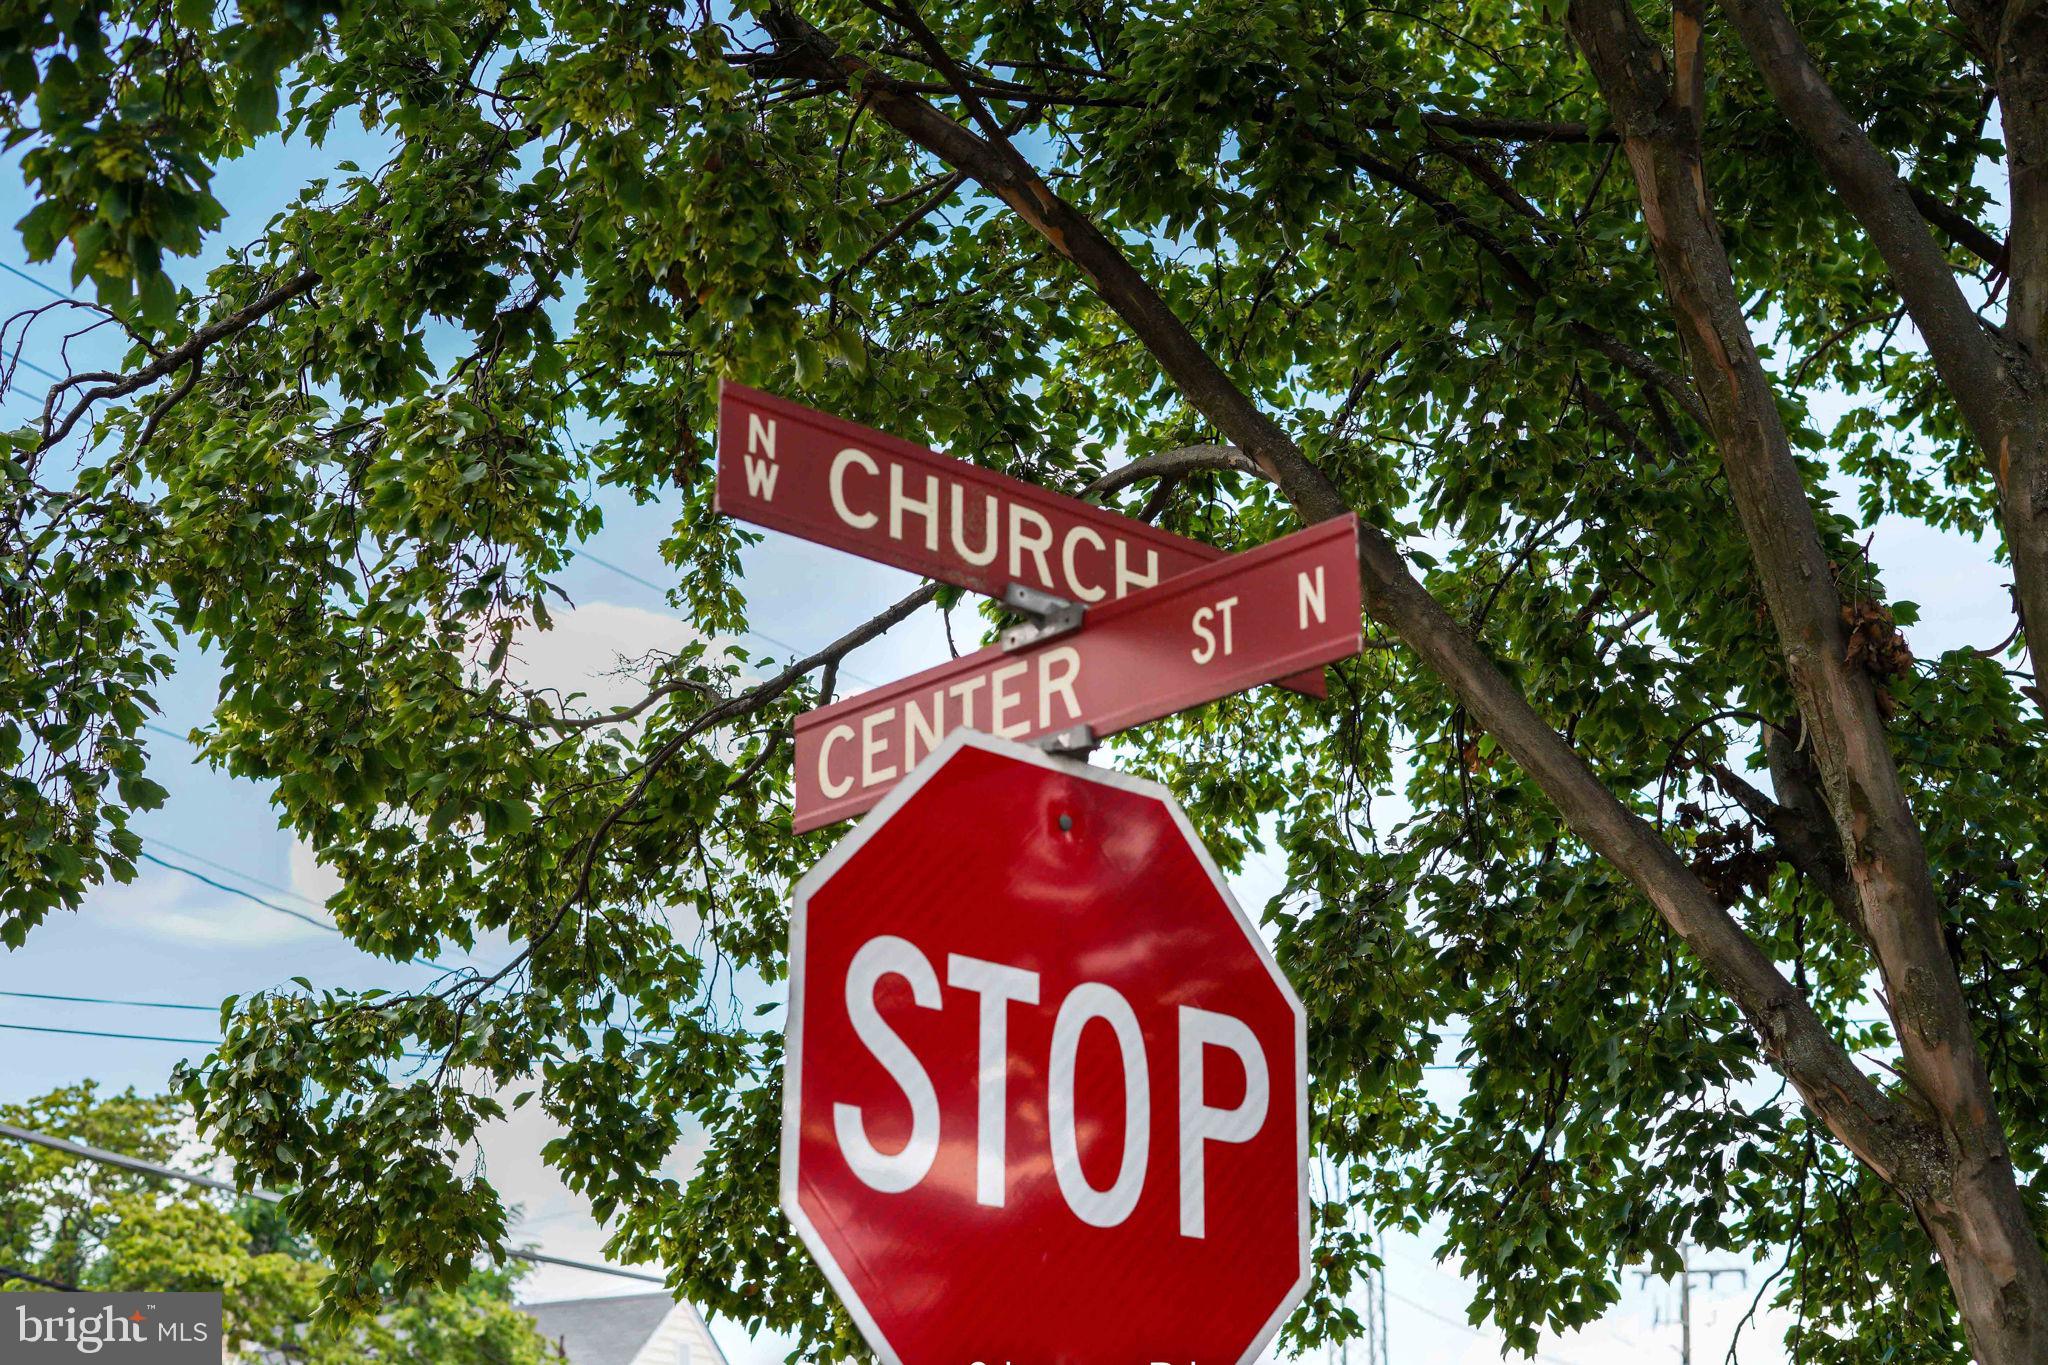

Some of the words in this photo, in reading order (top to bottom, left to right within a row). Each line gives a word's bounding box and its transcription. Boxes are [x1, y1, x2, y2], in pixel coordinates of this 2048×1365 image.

[829, 448, 1159, 601] CHURCH
[817, 646, 1083, 799] CENTER
[1191, 596, 1238, 665] ST
[1299, 566, 1327, 630] N
[833, 934, 1270, 1239] STOP
